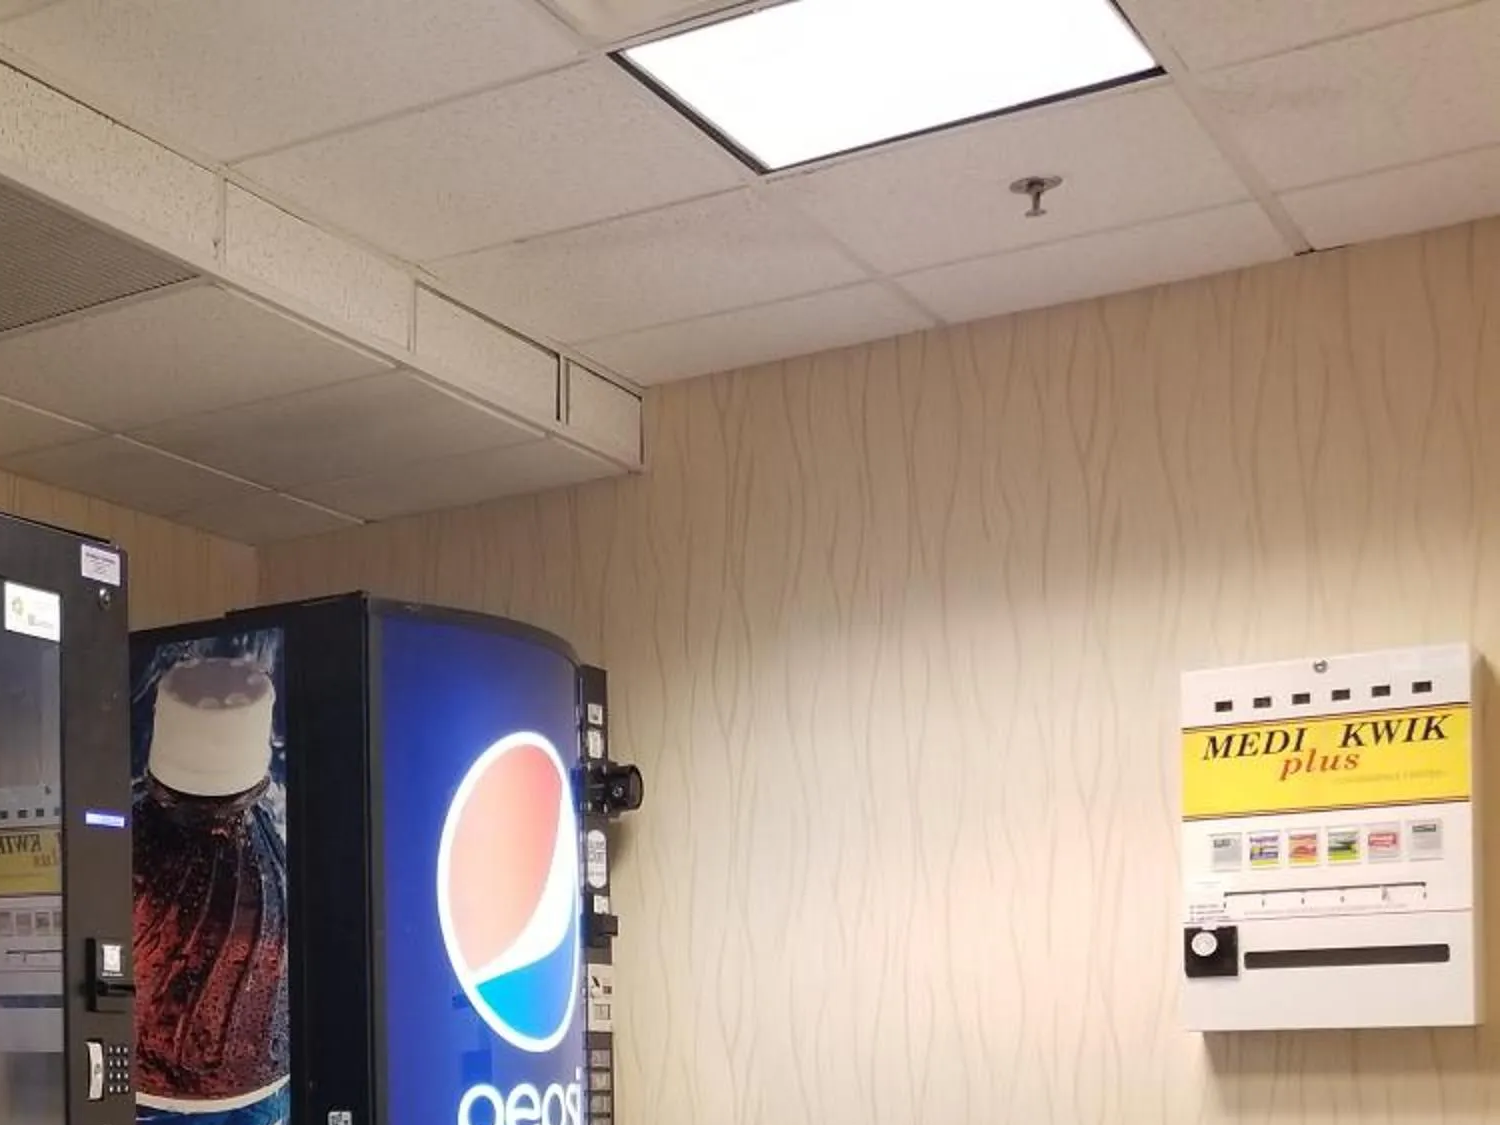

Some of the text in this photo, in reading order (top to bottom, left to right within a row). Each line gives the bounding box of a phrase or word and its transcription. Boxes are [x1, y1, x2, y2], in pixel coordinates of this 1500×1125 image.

[1202, 714, 1453, 760] MEDI KWIK
[1278, 748, 1360, 781] plus
